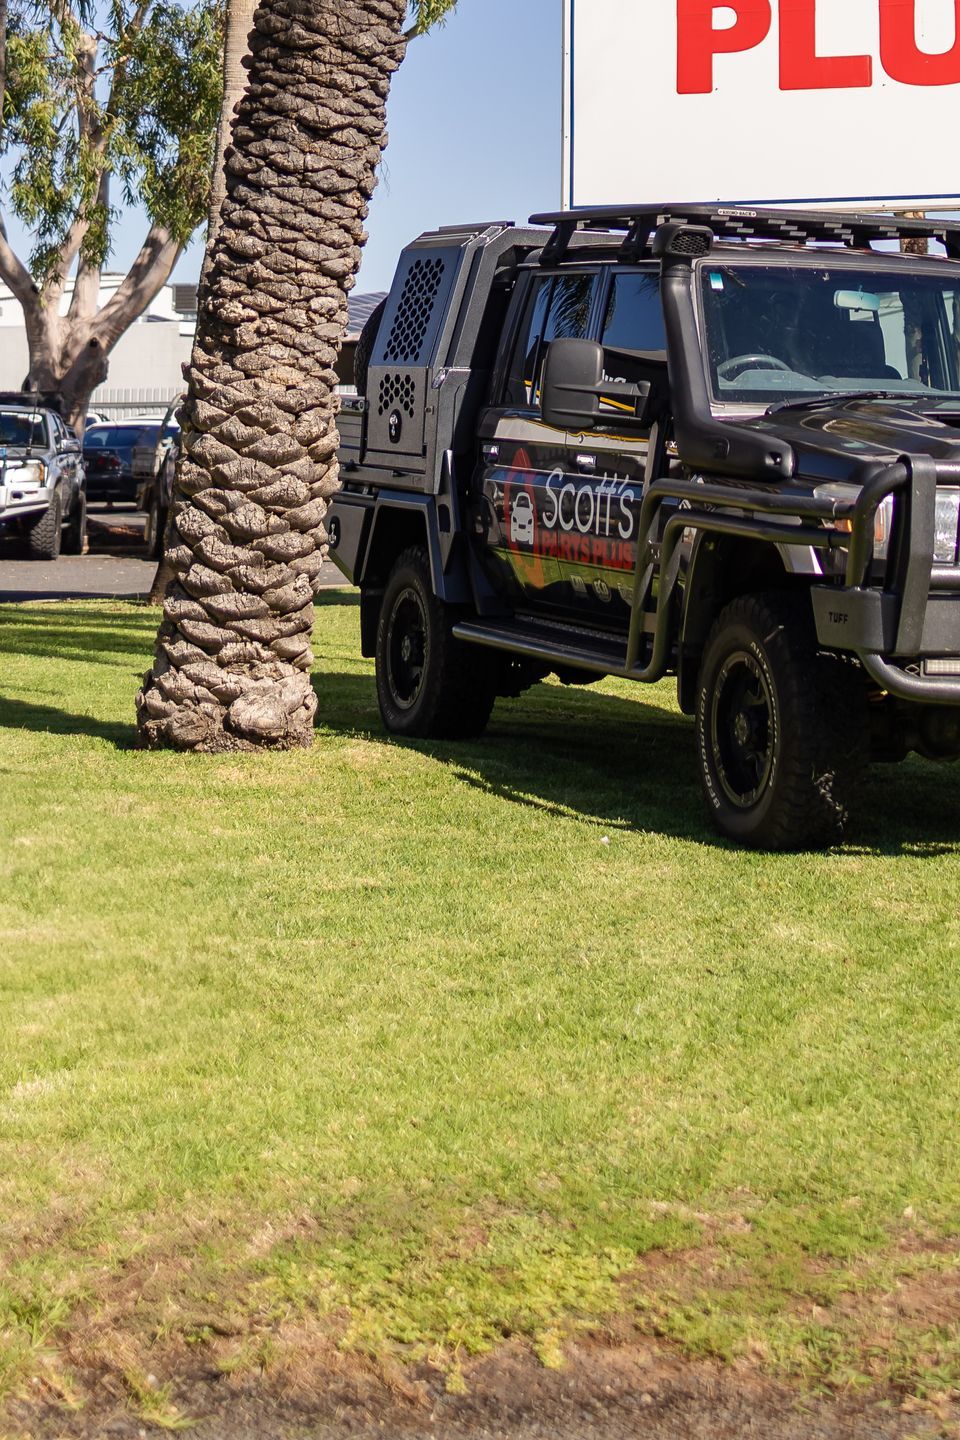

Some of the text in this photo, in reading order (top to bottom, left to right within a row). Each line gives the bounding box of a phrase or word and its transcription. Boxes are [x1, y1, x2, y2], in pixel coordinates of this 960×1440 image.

[542, 467, 635, 539] Scott's
[542, 529, 634, 570] PARTS PLUS
[828, 611, 849, 624] TUFF
